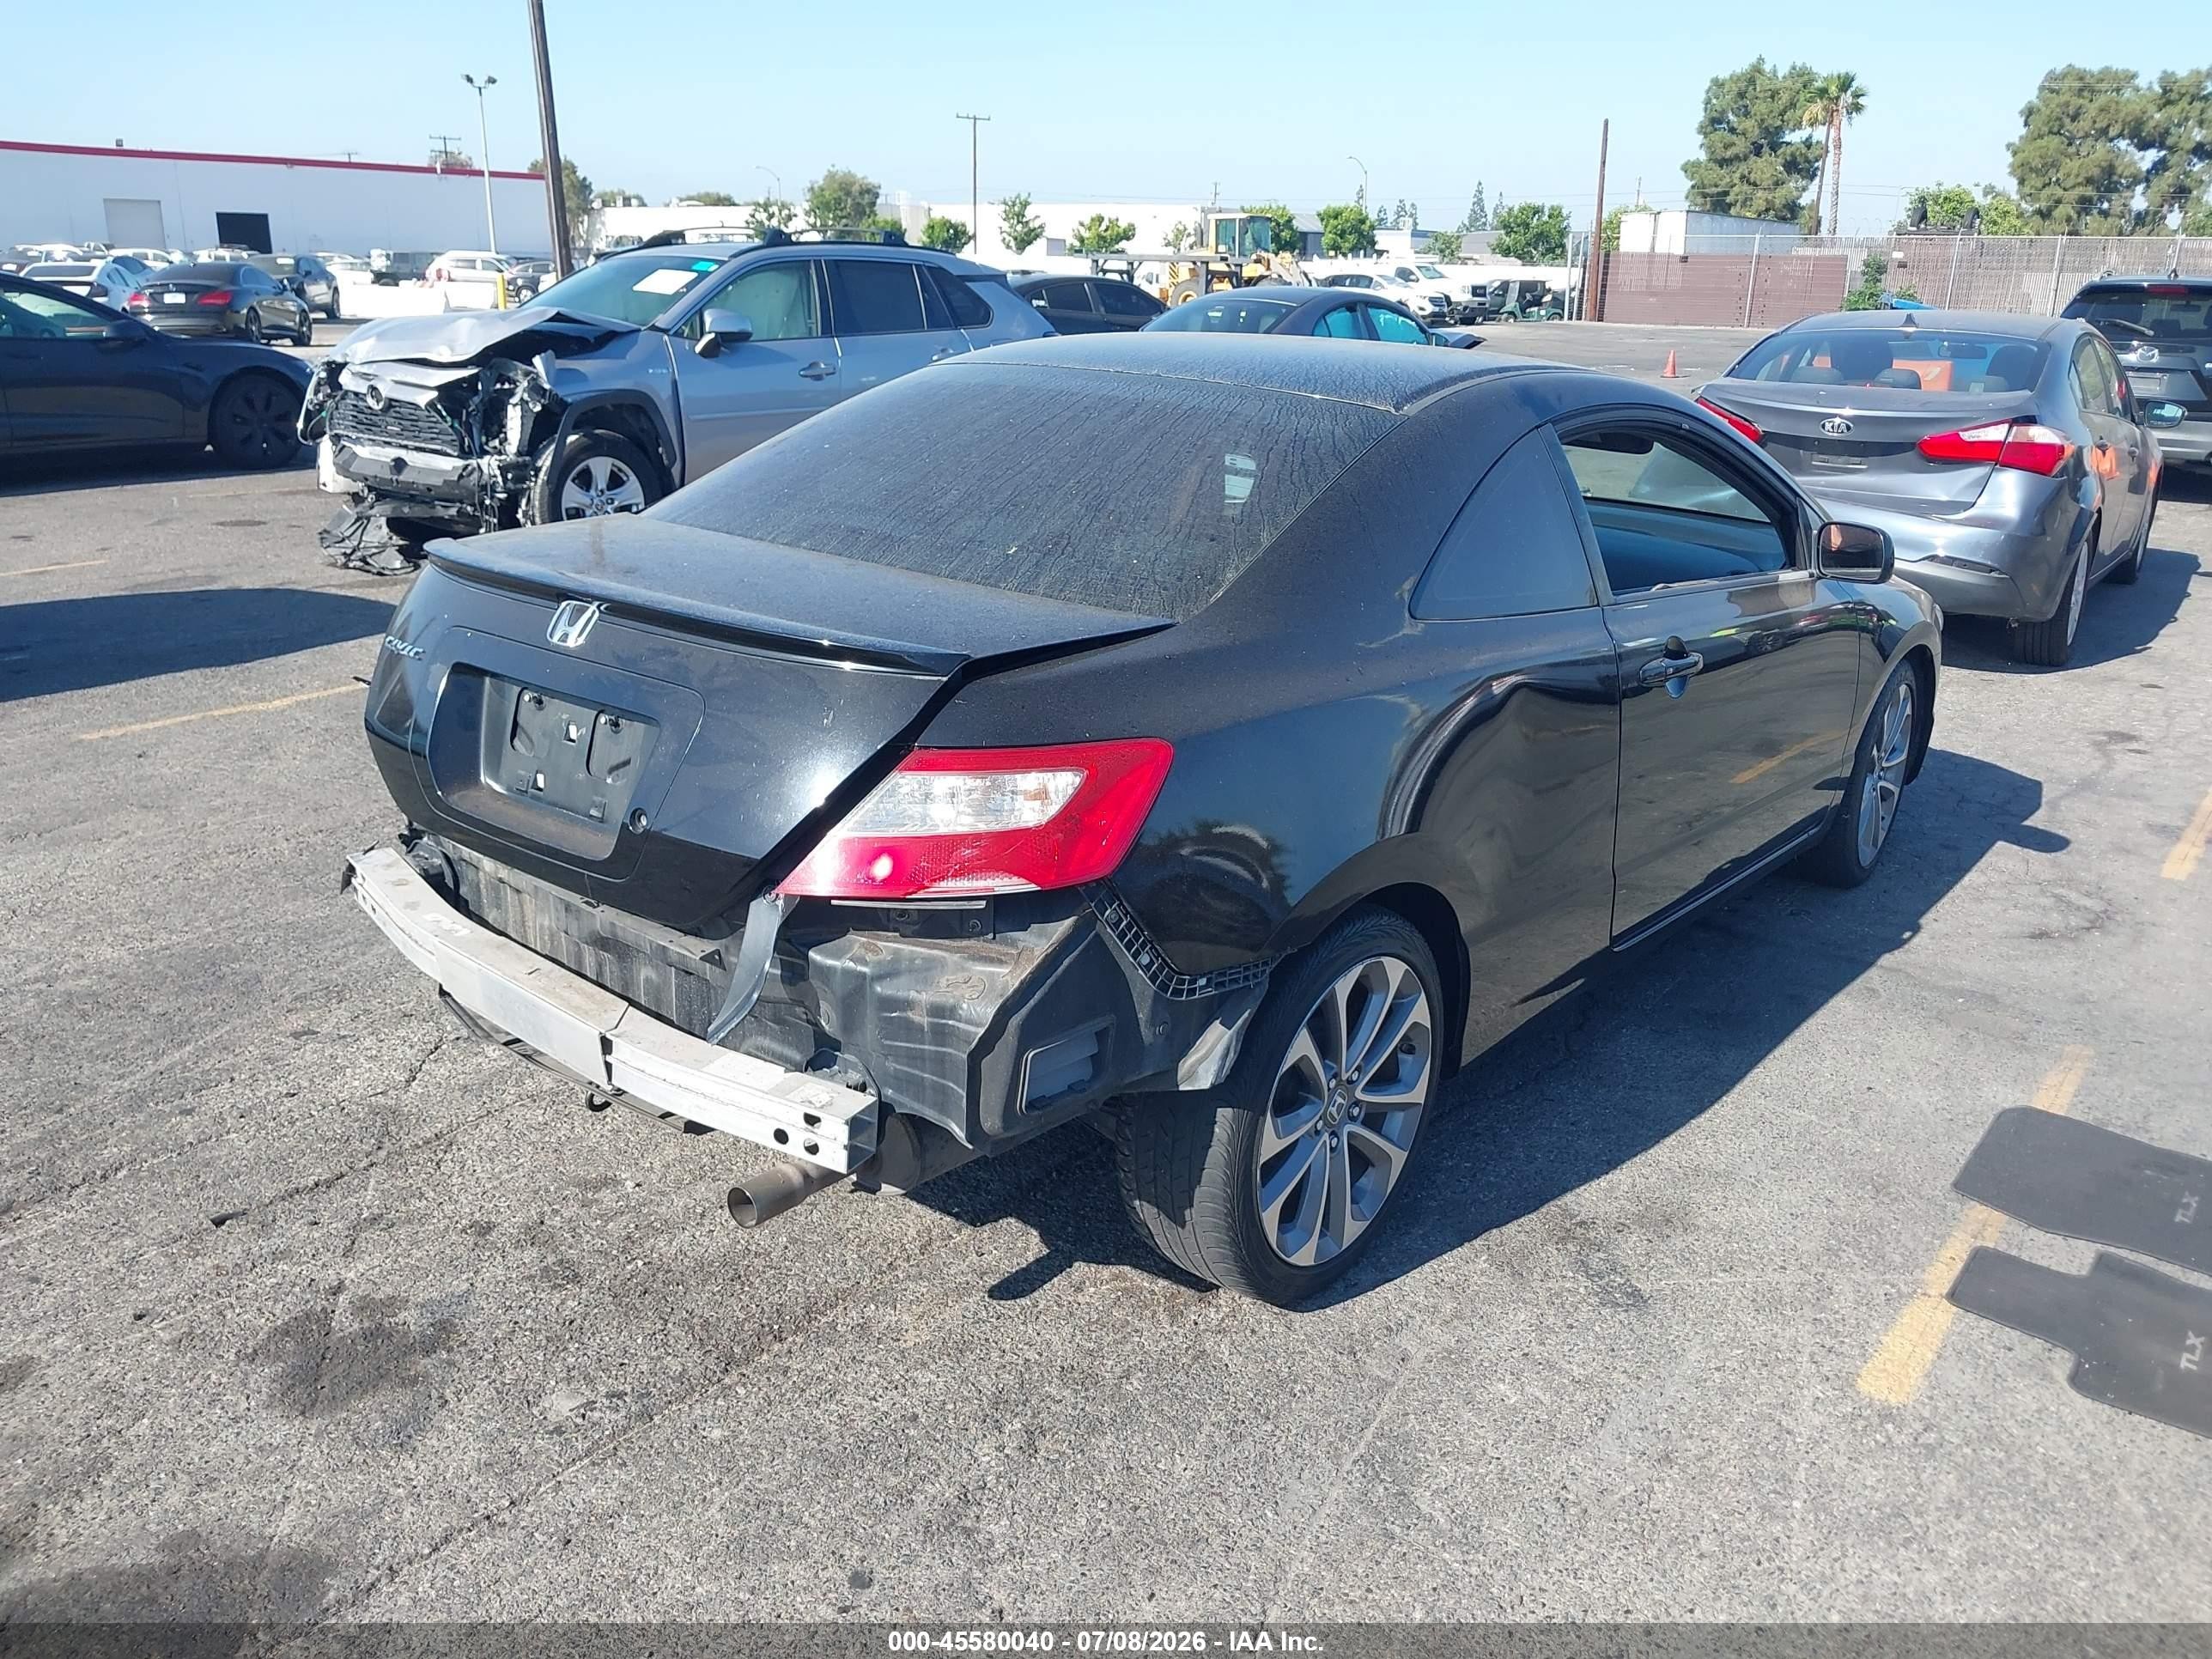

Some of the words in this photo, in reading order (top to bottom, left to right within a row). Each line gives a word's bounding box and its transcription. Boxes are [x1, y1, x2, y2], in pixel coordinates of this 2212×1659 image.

[1824, 421, 1847, 434] KIA
[385, 635, 427, 660] CIVIC
[2173, 1190, 2200, 1224] TLX
[2179, 1329, 2205, 1370] TLX
